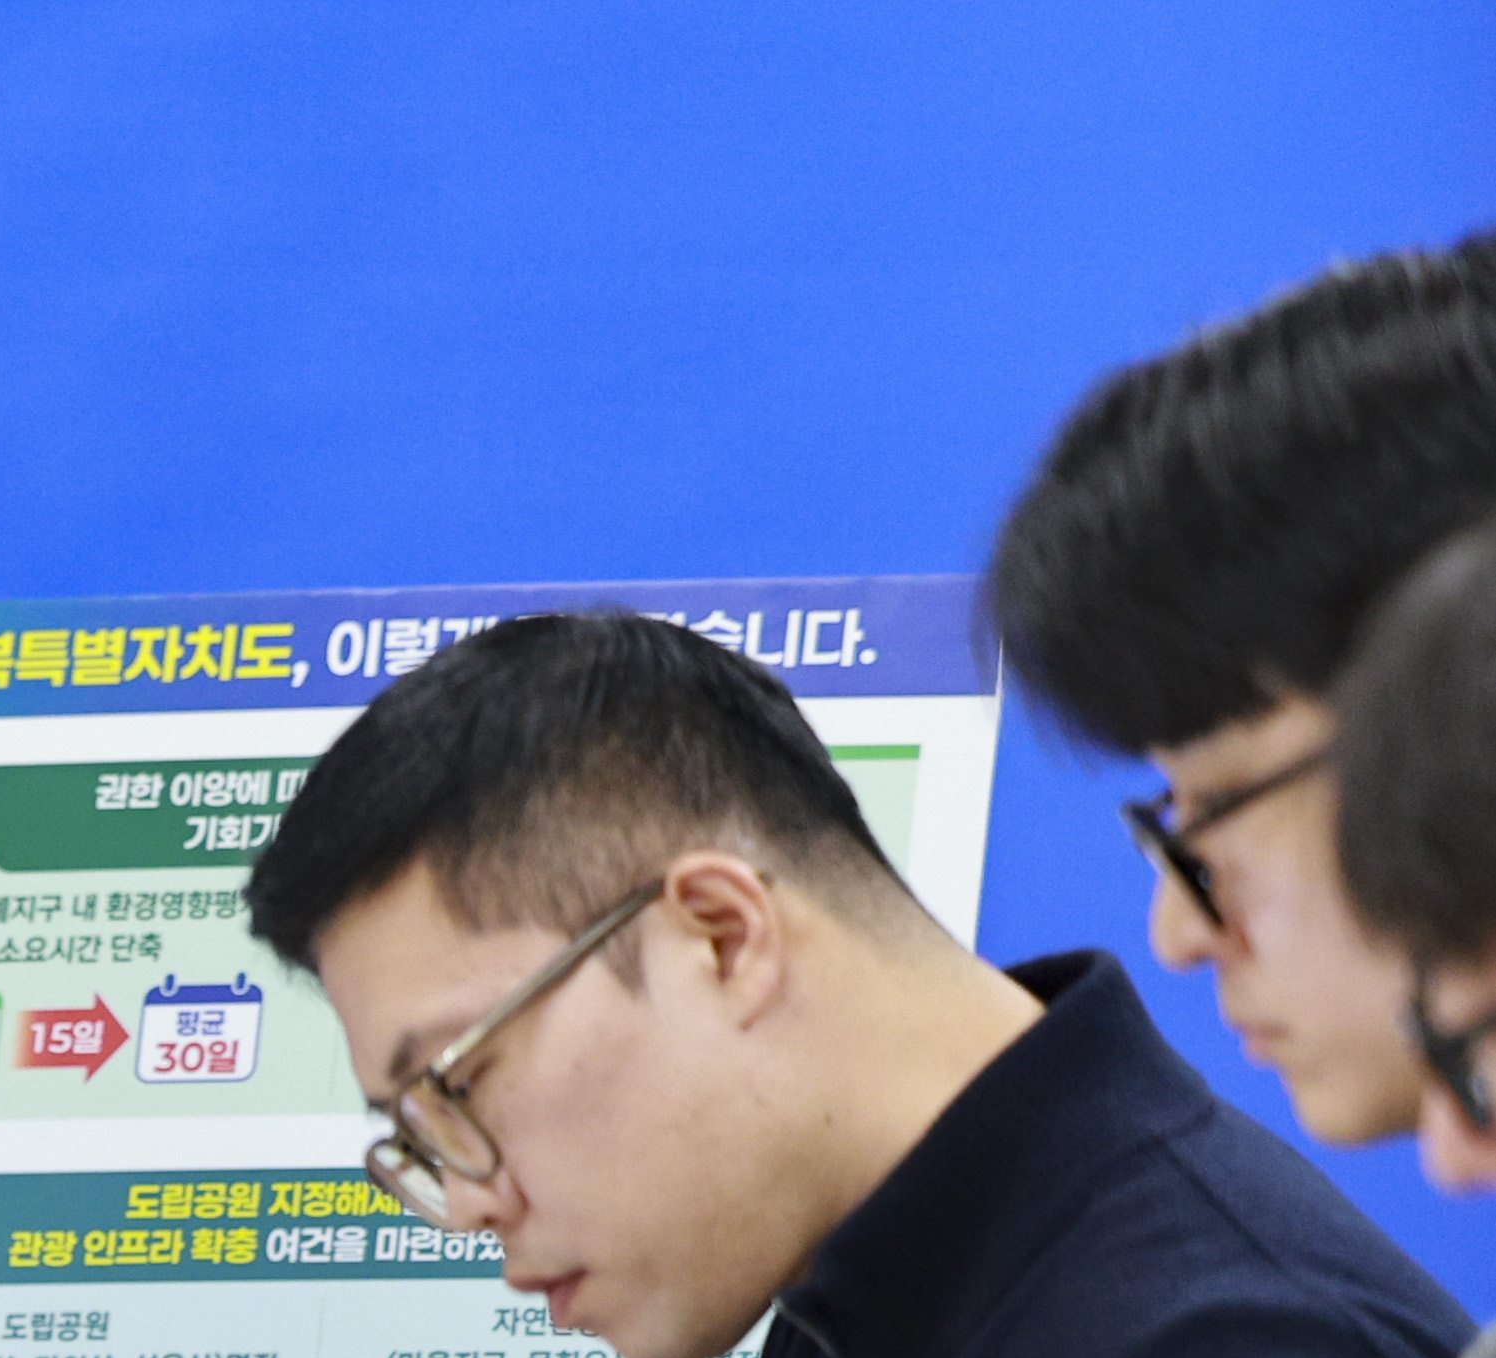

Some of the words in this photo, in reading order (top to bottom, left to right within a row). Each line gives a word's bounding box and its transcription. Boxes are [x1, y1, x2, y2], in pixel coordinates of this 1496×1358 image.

[95, 772, 166, 810] 권한
[169, 769, 273, 807] 이양에
[72, 892, 98, 922] 내
[107, 890, 250, 921] 환경영향평
[110, 932, 163, 963] 단축
[29, 1020, 105, 1055] 15일
[176, 1009, 226, 1037] 평균
[153, 1039, 240, 1075] 30일
[125, 1181, 261, 1220] 도립공원
[9, 1230, 77, 1268] 관광
[83, 1229, 184, 1266] 인프라
[190, 1228, 259, 1265] 확충
[266, 1226, 368, 1263] 여건을
[1, 1311, 110, 1341] 도립공원
